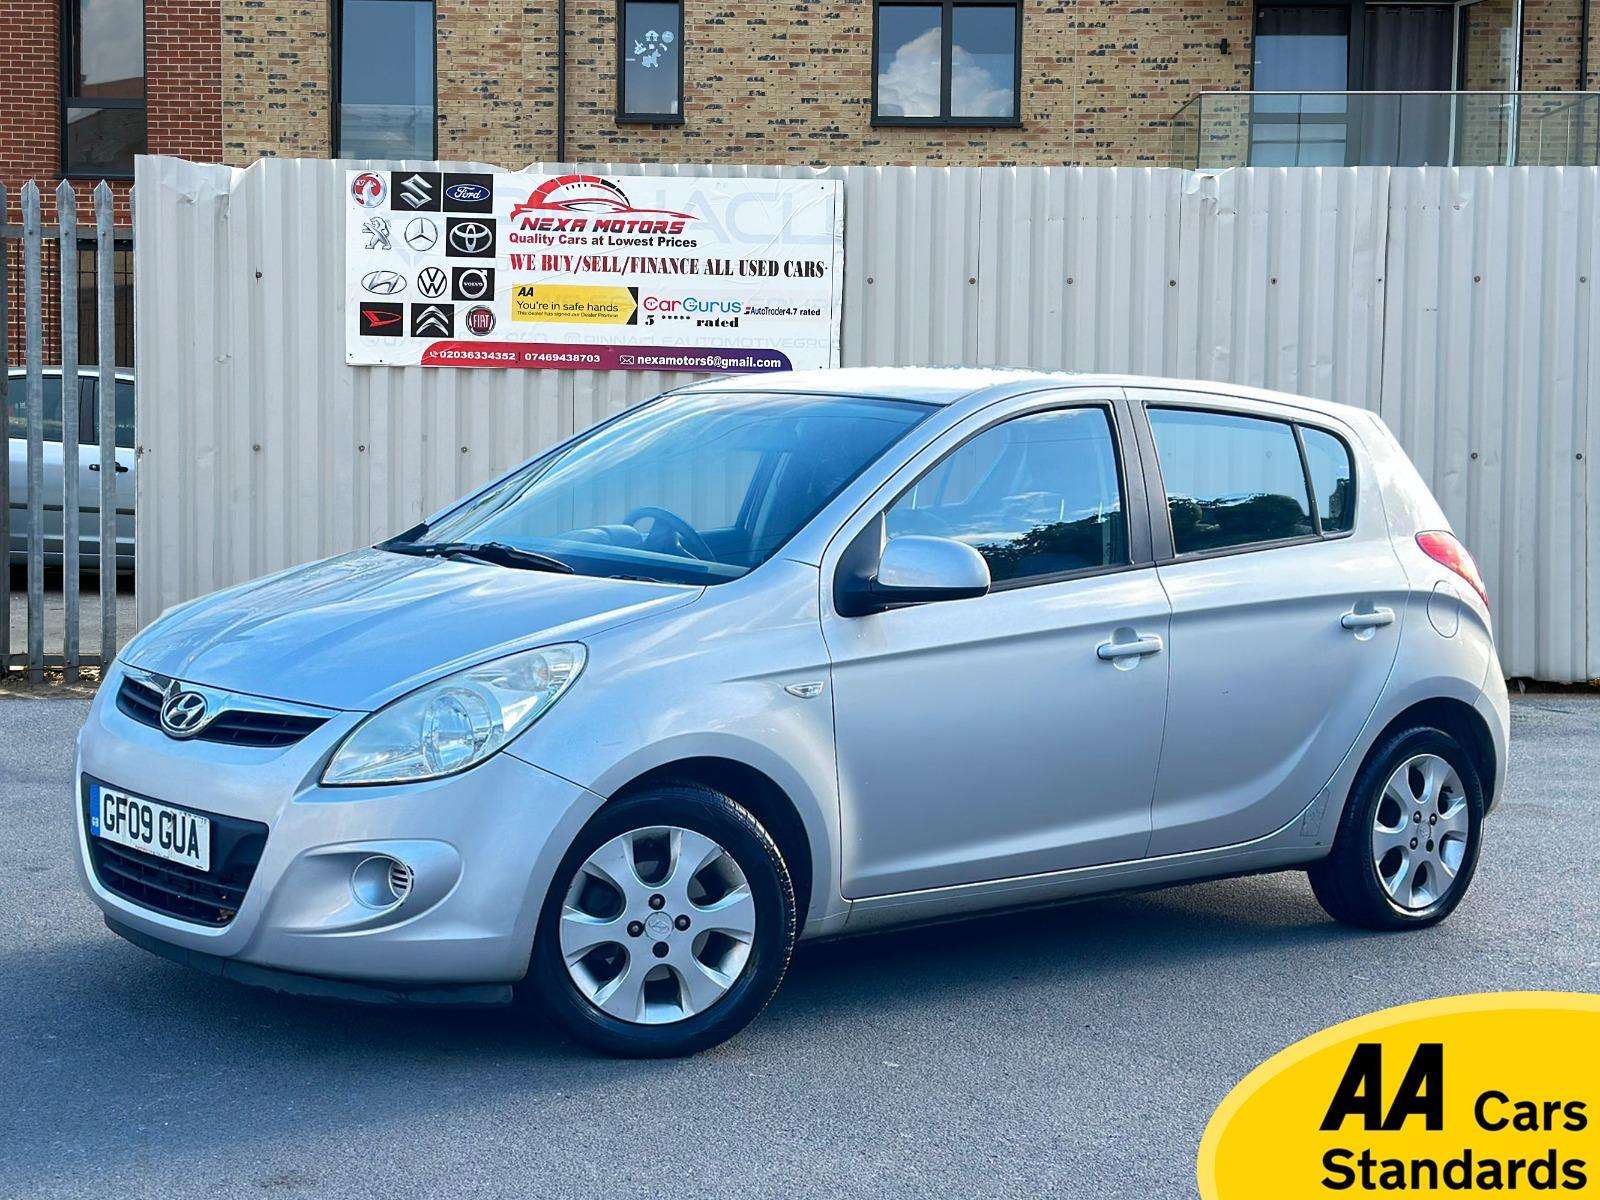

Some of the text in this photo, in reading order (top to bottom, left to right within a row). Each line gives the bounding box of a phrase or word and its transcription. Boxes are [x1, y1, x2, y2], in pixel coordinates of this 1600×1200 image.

[454, 187, 481, 199] Ford
[520, 217, 686, 235] NEXA MOTORS
[509, 232, 697, 248] Quality Cars at Lowest Prices
[510, 253, 824, 278] WE BUY/SELL/FINANCE ALL USED CARS
[518, 287, 534, 297] AA
[516, 300, 619, 312] You're in safe hands
[643, 296, 742, 313] CarGurus
[799, 308, 821, 316] rated
[473, 314, 490, 328] FIAT
[645, 315, 739, 328] 5 rated
[439, 351, 782, 369] 02036334352 07469438703 nexamotors6@gmail.com
[103, 793, 200, 860] GF09 GUA
